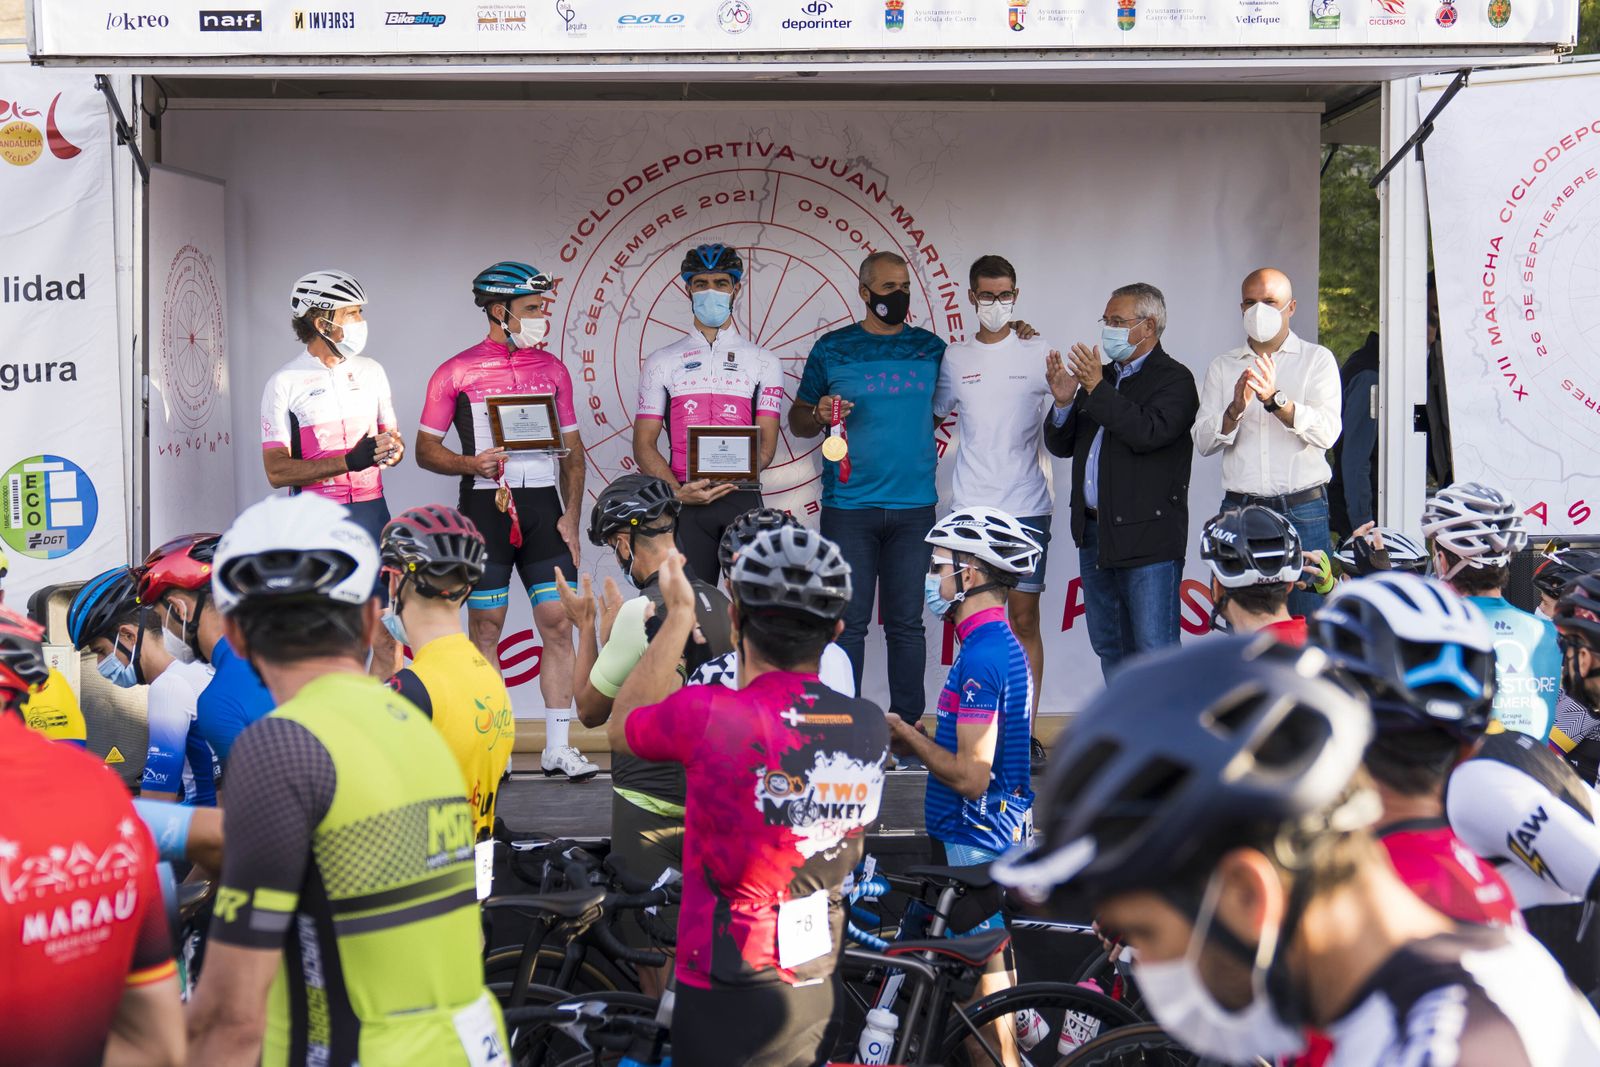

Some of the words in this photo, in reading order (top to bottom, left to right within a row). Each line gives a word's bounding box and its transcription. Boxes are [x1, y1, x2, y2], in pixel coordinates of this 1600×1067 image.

[106, 13, 169, 30] lokreo
[385, 12, 446, 28] Bikeshop
[782, 18, 852, 31] deporinter
[1236, 15, 1281, 25] Velefique
[560, 141, 796, 264] CICLODEPORTIVA
[810, 157, 887, 204] JUAN
[698, 189, 756, 209] 2021
[1523, 167, 1599, 283] SEPTIEMBRE
[585, 204, 689, 337] SEPTIEMBRE
[4, 273, 86, 302] lidad
[1482, 235, 1504, 346] MARCHA
[1525, 293, 1535, 322] DE
[1530, 331, 1548, 358] 26
[584, 349, 596, 383] DE
[1497, 355, 1529, 403] XVII
[588, 395, 608, 427] 26
[26, 474, 41, 526] ECO
[43, 535, 65, 546] DGT
[816, 782, 869, 803] TWO
